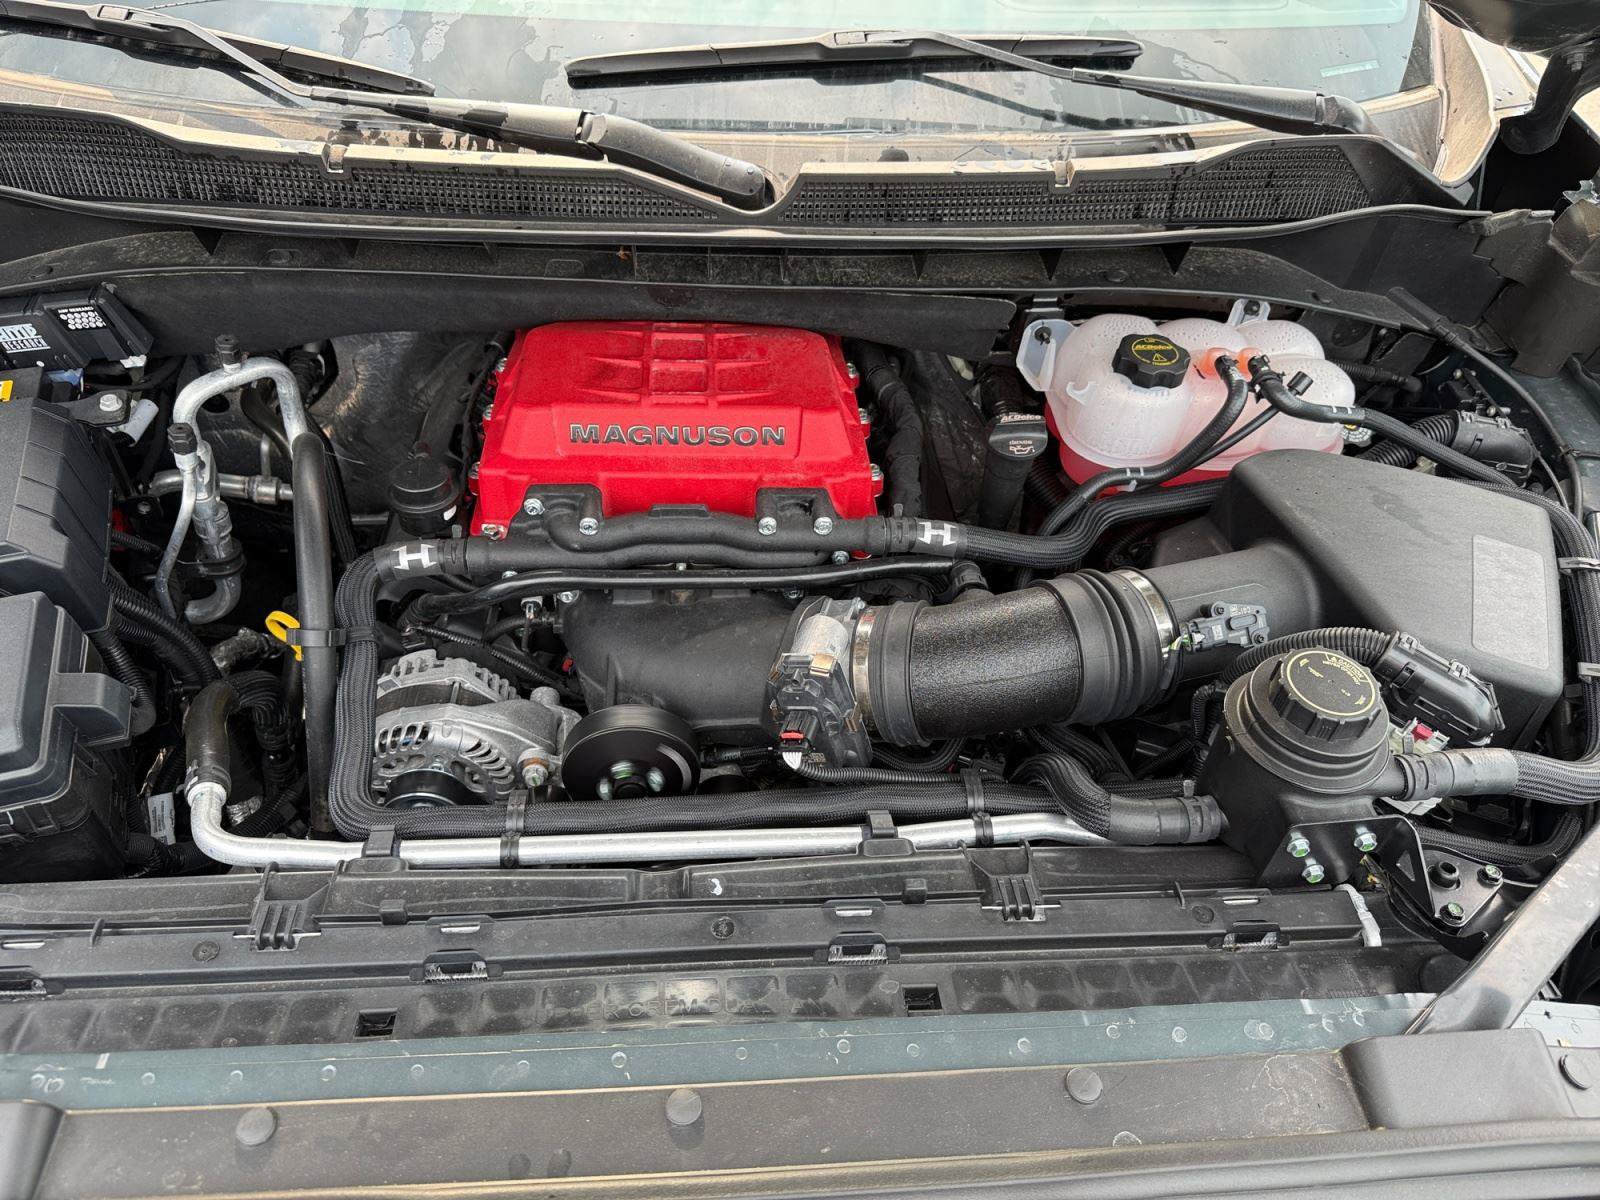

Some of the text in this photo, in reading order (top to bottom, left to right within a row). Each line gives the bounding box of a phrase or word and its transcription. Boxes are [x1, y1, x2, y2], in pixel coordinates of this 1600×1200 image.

[1, 338, 48, 351] RESEARCH
[1000, 413, 1041, 423] ACDelco
[569, 423, 785, 446] MAGNUSON
[1338, 659, 1364, 678] CAUTION
